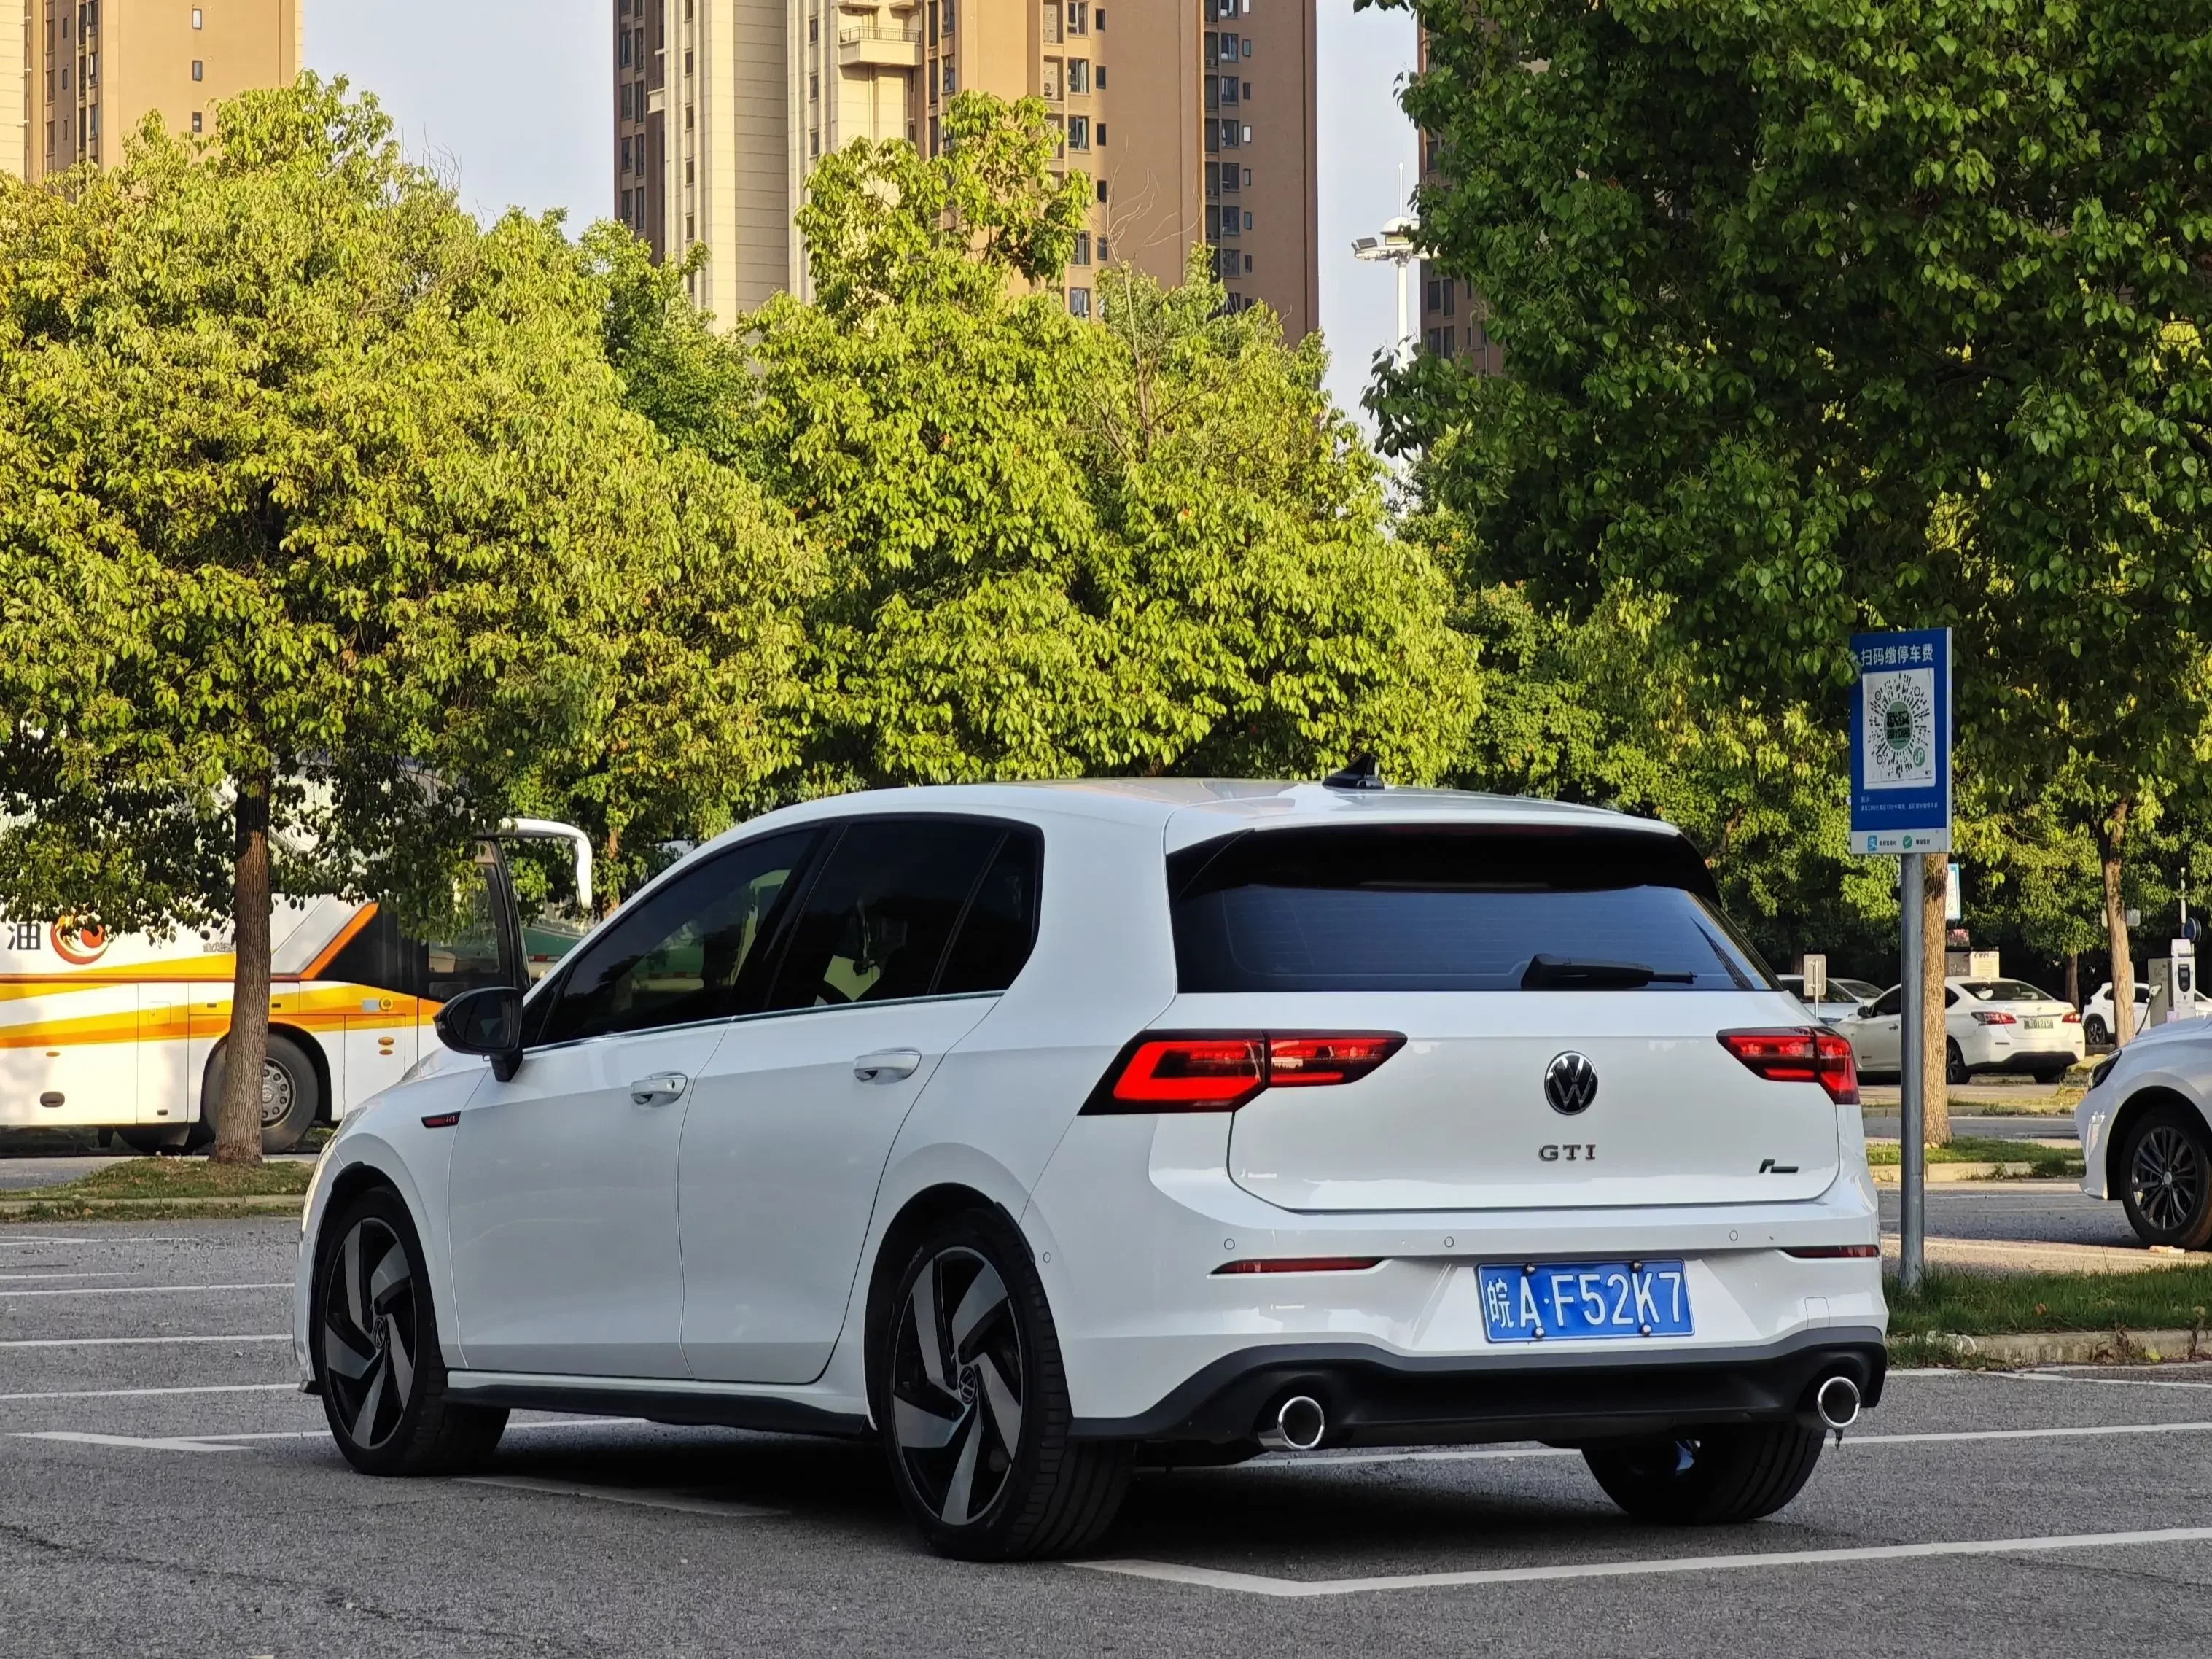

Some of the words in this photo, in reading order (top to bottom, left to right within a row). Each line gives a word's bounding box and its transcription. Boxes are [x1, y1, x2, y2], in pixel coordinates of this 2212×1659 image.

[1861, 643, 1933, 666] 扫码缴停车费
[7, 921, 41, 950] 油
[1538, 1143, 1597, 1162] GTI
